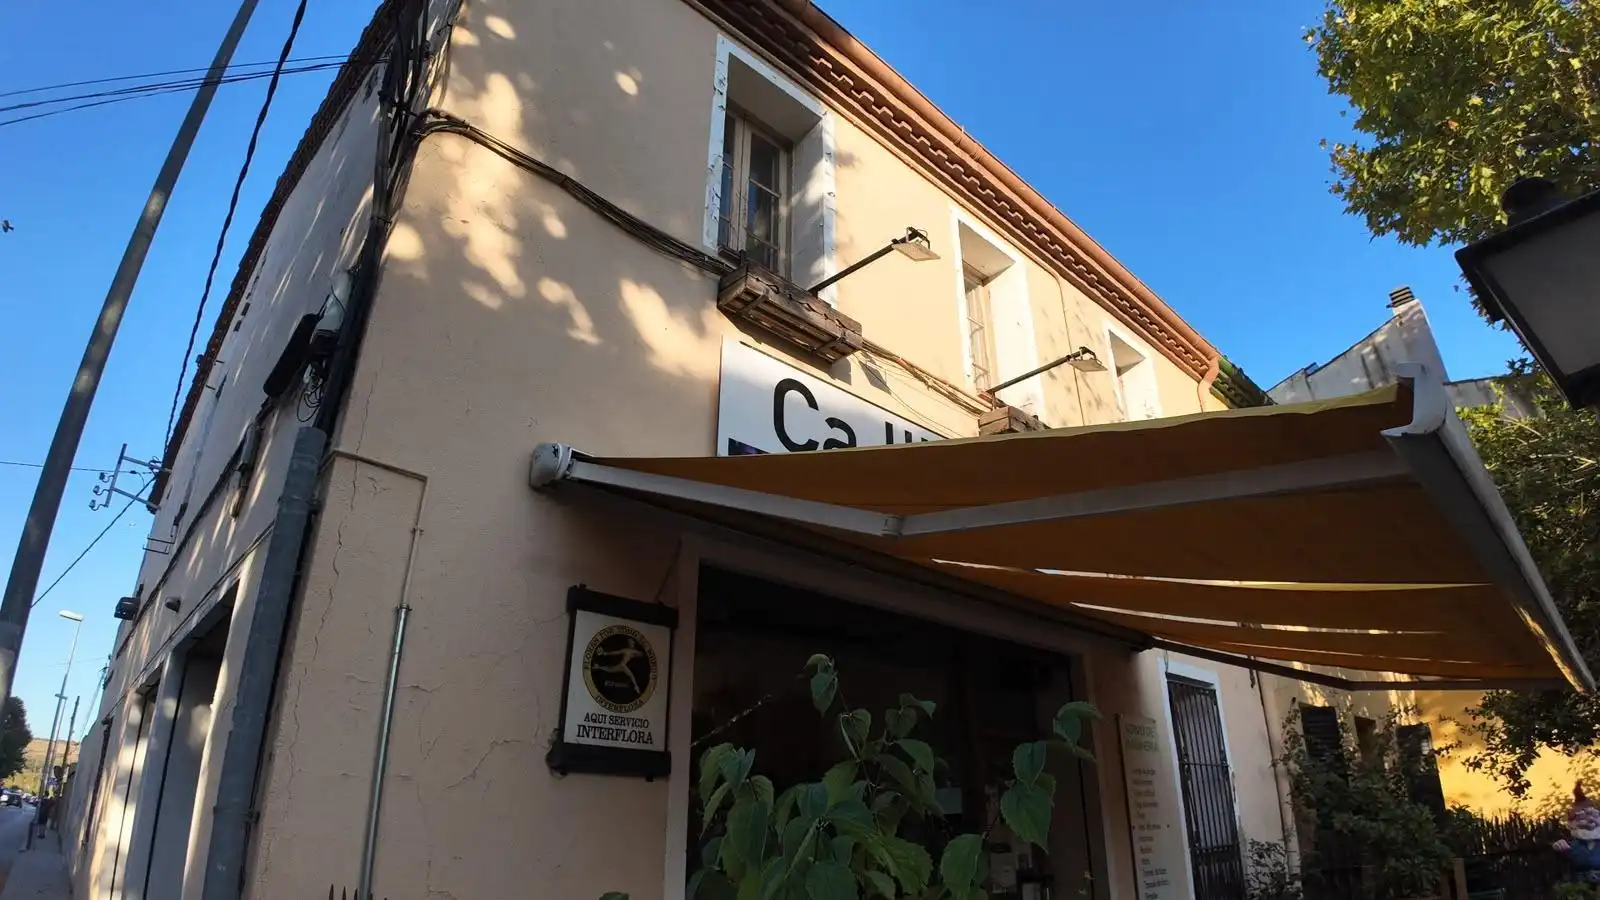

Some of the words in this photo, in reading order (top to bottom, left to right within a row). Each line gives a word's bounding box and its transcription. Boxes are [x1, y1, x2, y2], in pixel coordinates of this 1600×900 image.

[584, 712, 607, 724] AQUI
[609, 716, 649, 728] SERVICIO
[577, 725, 653, 744] INTERFLORA
